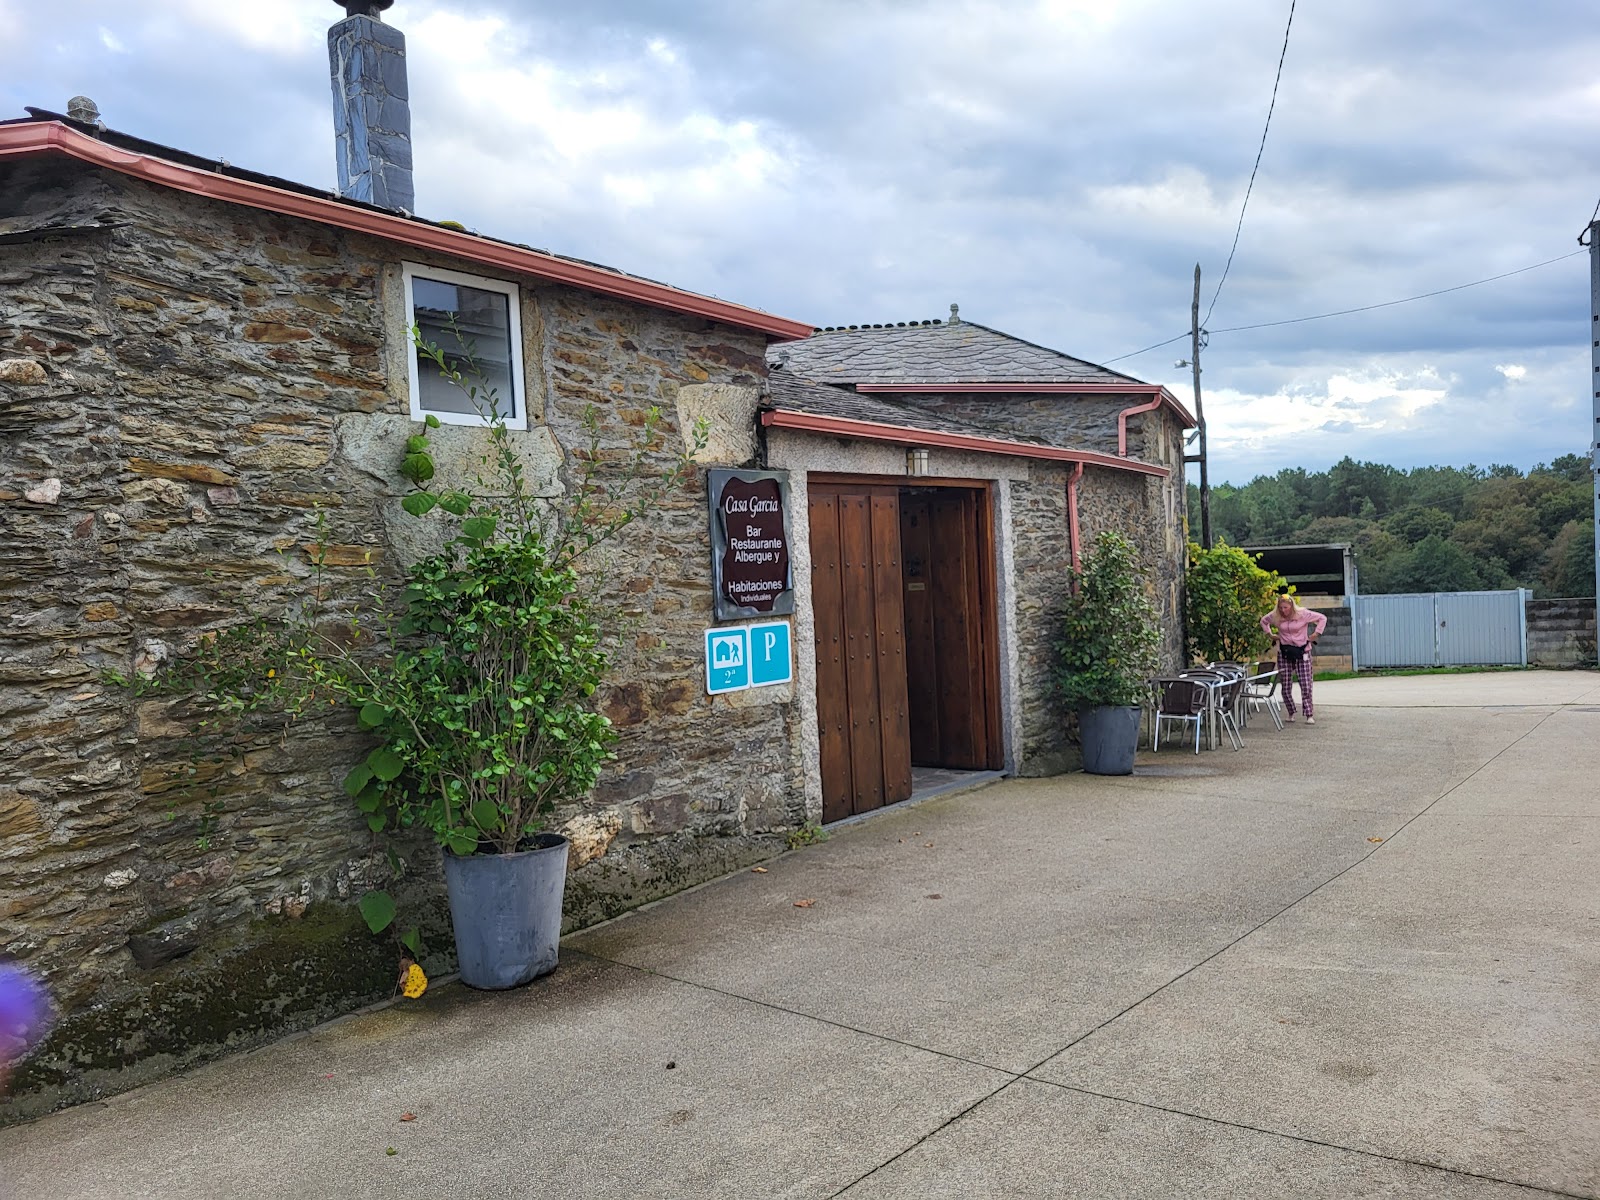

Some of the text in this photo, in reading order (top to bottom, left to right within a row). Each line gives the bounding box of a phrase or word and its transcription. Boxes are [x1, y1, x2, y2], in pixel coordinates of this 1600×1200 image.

[725, 496, 747, 514] Casa
[746, 525, 762, 537] Bar
[731, 538, 782, 550] Restaurante
[735, 551, 780, 564] Albergue y
[728, 580, 782, 592] Habitaciones
[740, 594, 772, 602] Individuales
[764, 632, 776, 661] P
